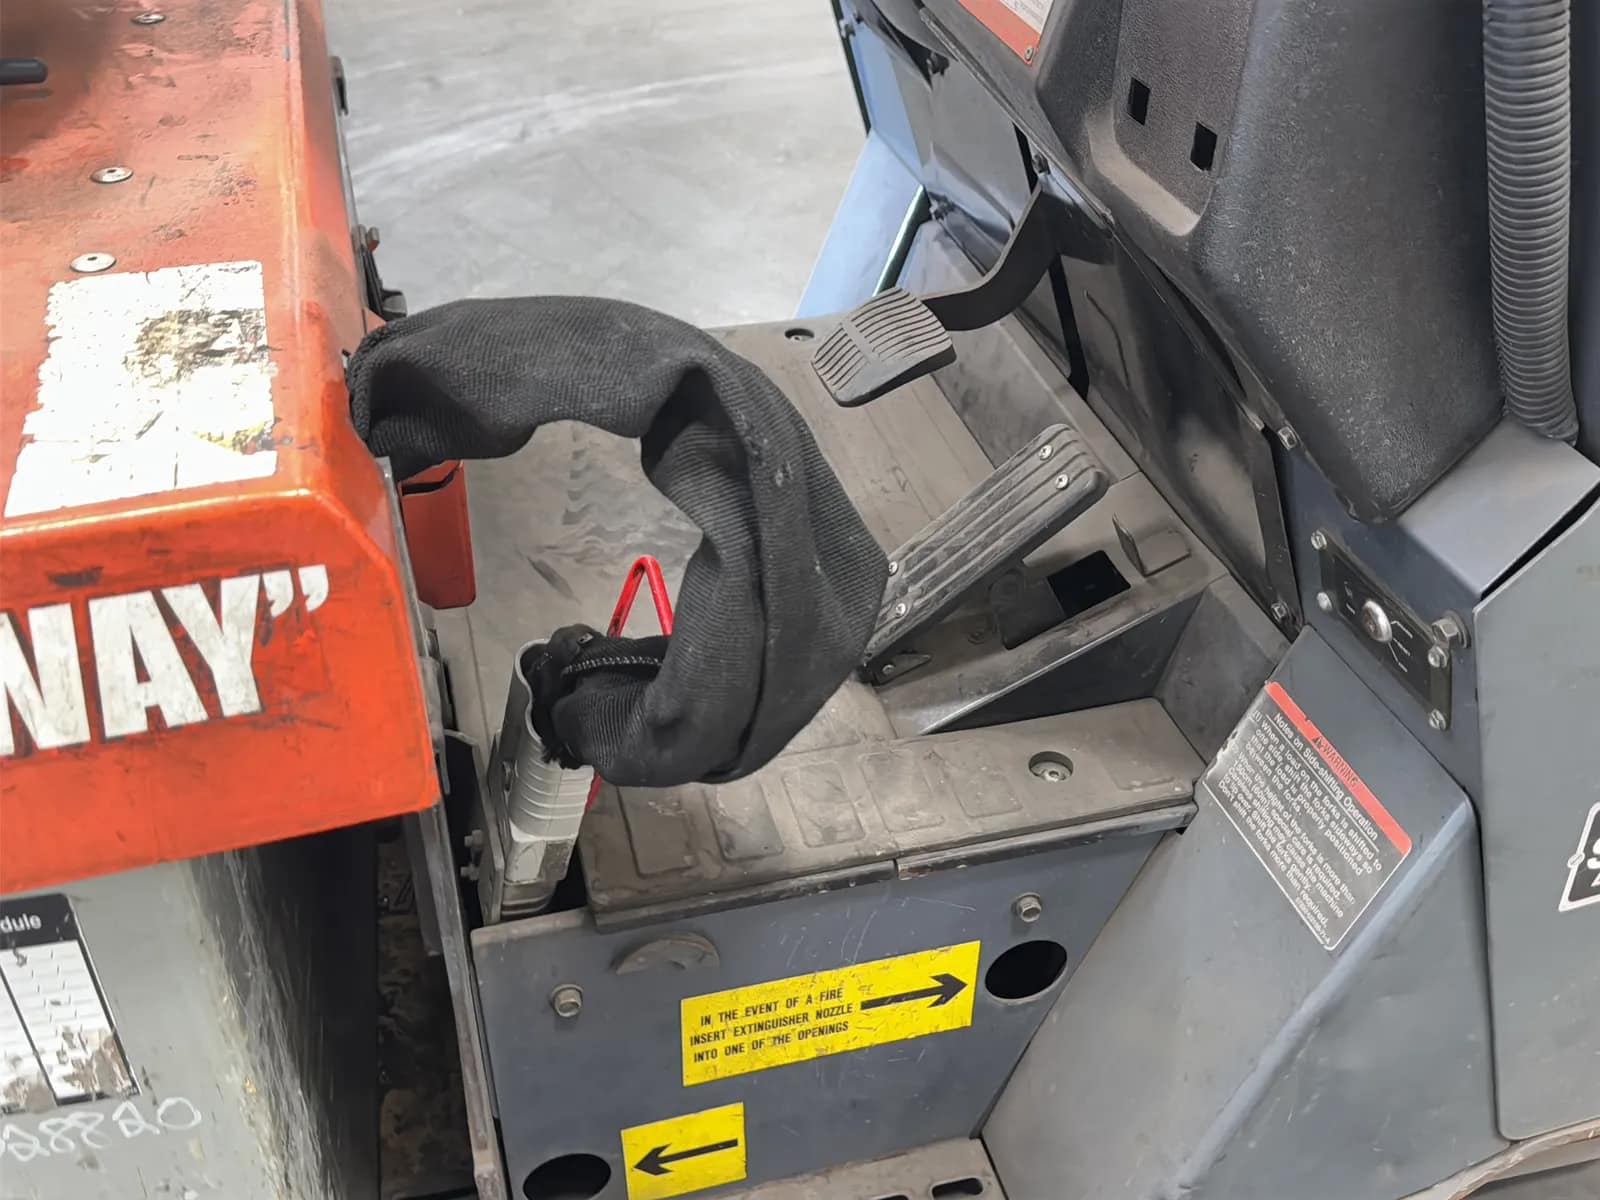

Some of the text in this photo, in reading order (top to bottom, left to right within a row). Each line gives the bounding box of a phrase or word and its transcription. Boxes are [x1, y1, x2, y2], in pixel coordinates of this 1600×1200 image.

[1250, 733, 1363, 876] that the load is properly positioned
[1254, 727, 1269, 746] one
[1283, 761, 1301, 784] shift
[1299, 781, 1313, 799] the
[1311, 796, 1331, 821] forks
[1328, 818, 1364, 862] sideways
[1361, 860, 1373, 874] so
[1260, 719, 1281, 745] When
[1278, 743, 1285, 751] a
[1284, 748, 1302, 770] load
[1299, 768, 1310, 782] on
[1309, 779, 1323, 797] the
[1321, 795, 1342, 820] forks
[1340, 817, 1349, 829] is
[1347, 826, 1374, 860] shifted
[1372, 857, 1383, 871] to
[1271, 774, 1284, 791] the
[1273, 712, 1380, 841] Notes on Side-shifting Operation
[1323, 744, 1358, 786] WARNING
[1222, 773, 1231, 784] to
[1264, 827, 1277, 844] the
[1274, 841, 1292, 865] forks
[1232, 798, 1247, 818] shift
[1244, 815, 1257, 832] the
[1254, 828, 1272, 851] forks
[1269, 848, 1287, 872] more
[1285, 868, 1302, 891] than
[1237, 751, 1256, 776] When
[1253, 772, 1266, 788] the
[1262, 785, 1284, 813] height
[1282, 808, 1292, 821] of
[1289, 817, 1302, 835] the
[1299, 831, 1318, 855] forks
[1315, 852, 1325, 864] is
[1322, 861, 1341, 886] more
[1251, 797, 1275, 828] shifting
[1270, 825, 1287, 846] may
[1285, 842, 1306, 869] cause
[1304, 866, 1317, 884] the
[1314, 880, 1344, 919] machine
[1269, 806, 1293, 838] special
[1290, 835, 1307, 856] care
[1305, 853, 1314, 865] is
[690, 1003, 853, 1046] INSERT EXTINGUISHER NOZZLE
[694, 1021, 849, 1062] INTO ONE OF THE OPENINGS
[701, 988, 843, 1026] IN THE EVENT OF A FIRE
